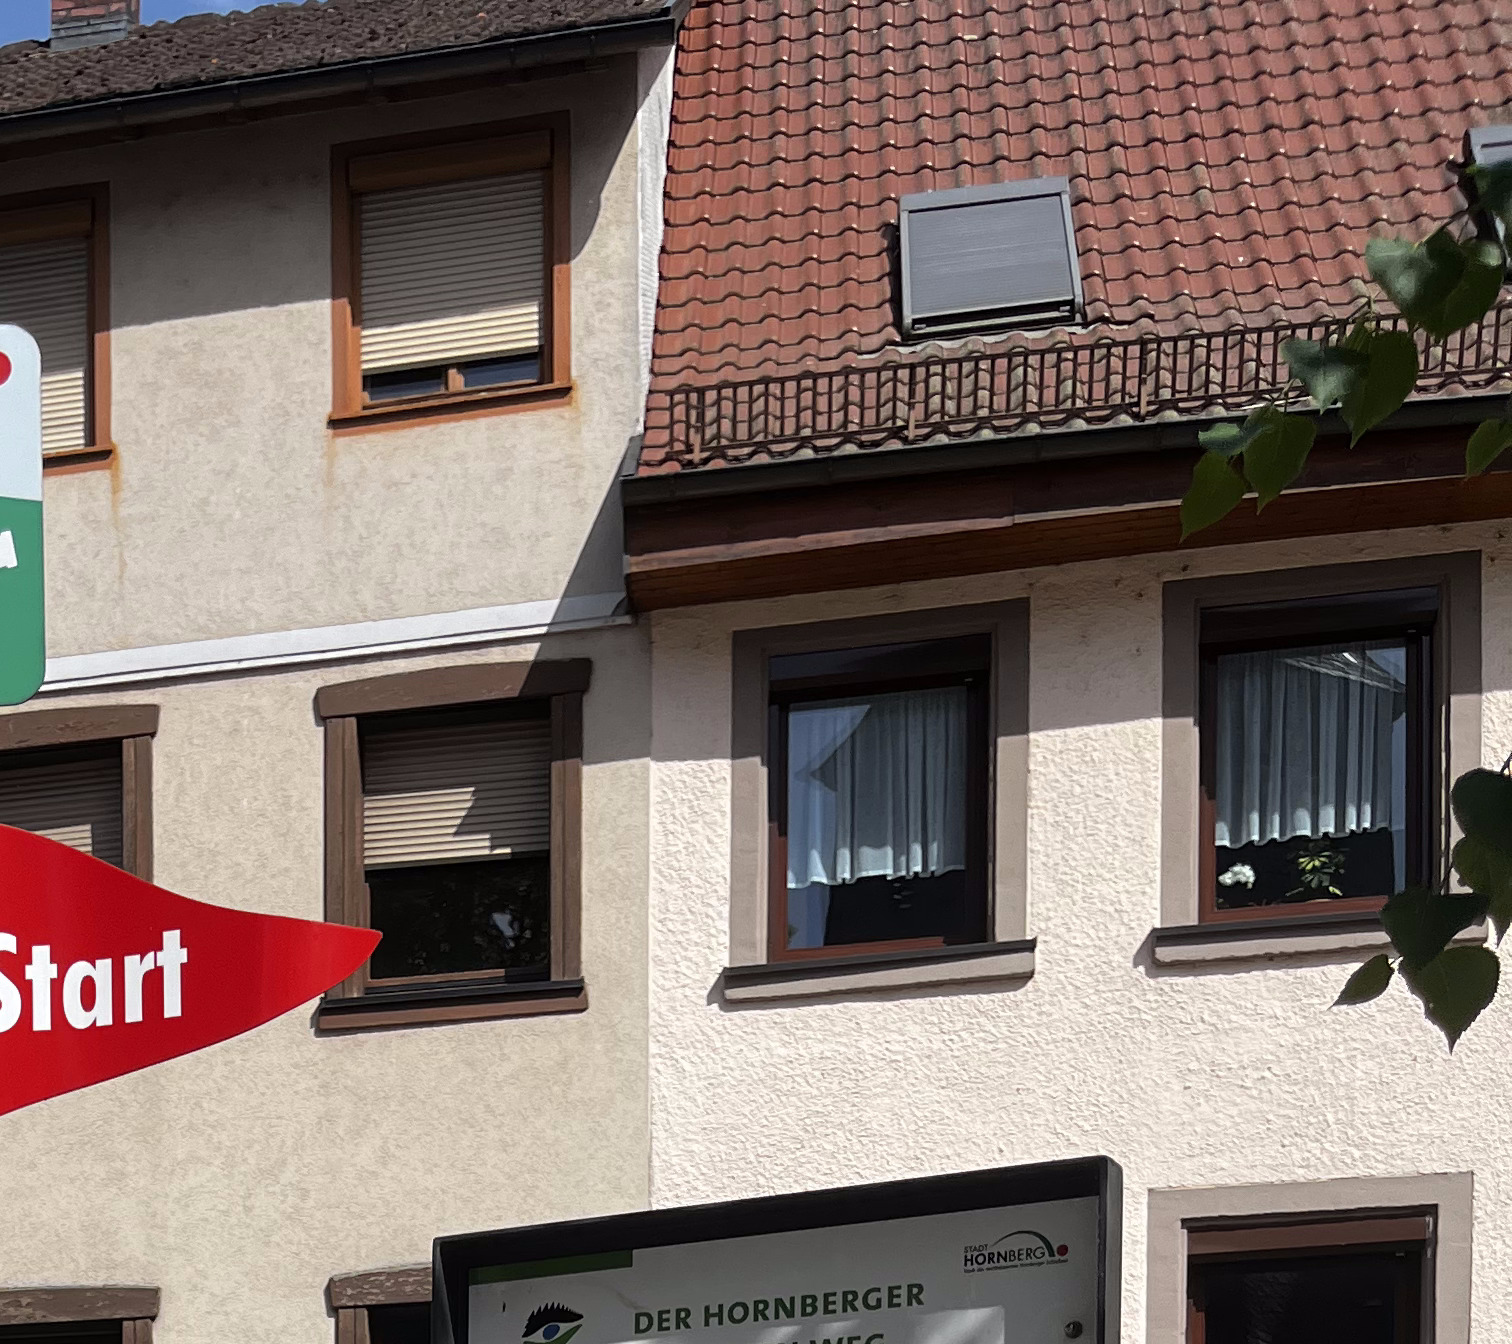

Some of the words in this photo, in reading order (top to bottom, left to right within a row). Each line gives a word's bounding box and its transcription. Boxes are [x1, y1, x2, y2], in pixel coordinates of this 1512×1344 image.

[963, 1246, 1046, 1267] HORNBERG
[964, 1243, 989, 1254] STADT
[634, 1307, 692, 1335] DER
[703, 1283, 925, 1328] HORNBERGER
